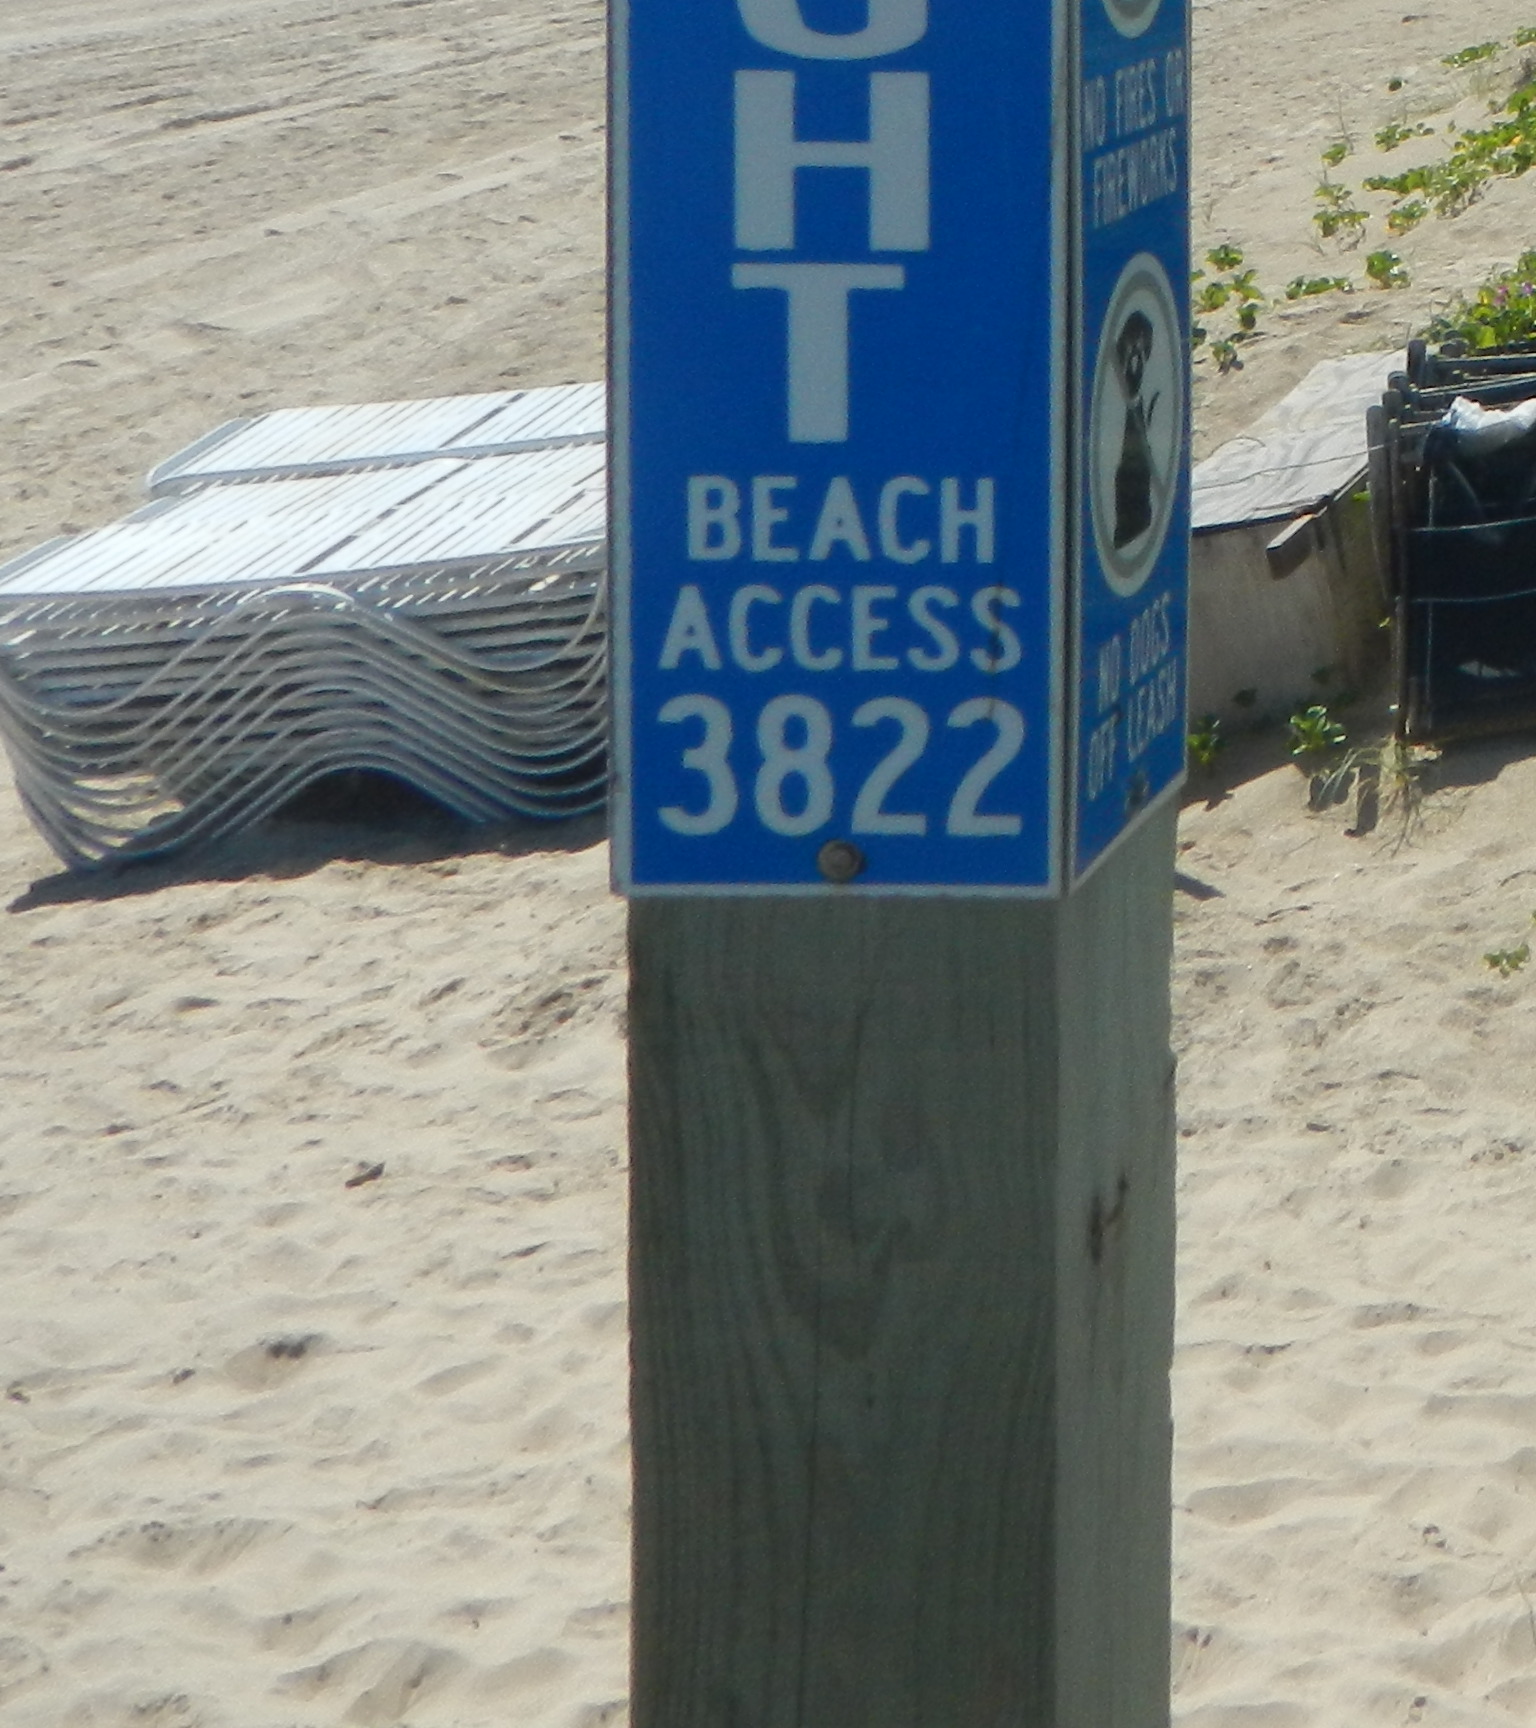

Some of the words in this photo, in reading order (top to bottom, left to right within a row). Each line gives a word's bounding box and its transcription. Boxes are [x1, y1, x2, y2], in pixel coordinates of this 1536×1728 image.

[1084, 76, 1106, 151] NO
[1115, 58, 1157, 135] FIRES
[1165, 48, 1185, 118] OR
[1093, 127, 1178, 228] FIREWORKS
[687, 475, 995, 564] BEACH
[658, 583, 1022, 673] ACCESS
[1099, 634, 1121, 713] NO
[1129, 591, 1170, 685] DOGS
[656, 695, 1025, 836] 3822
[1088, 712, 1117, 801] OFF
[1127, 658, 1178, 763] LEASH
